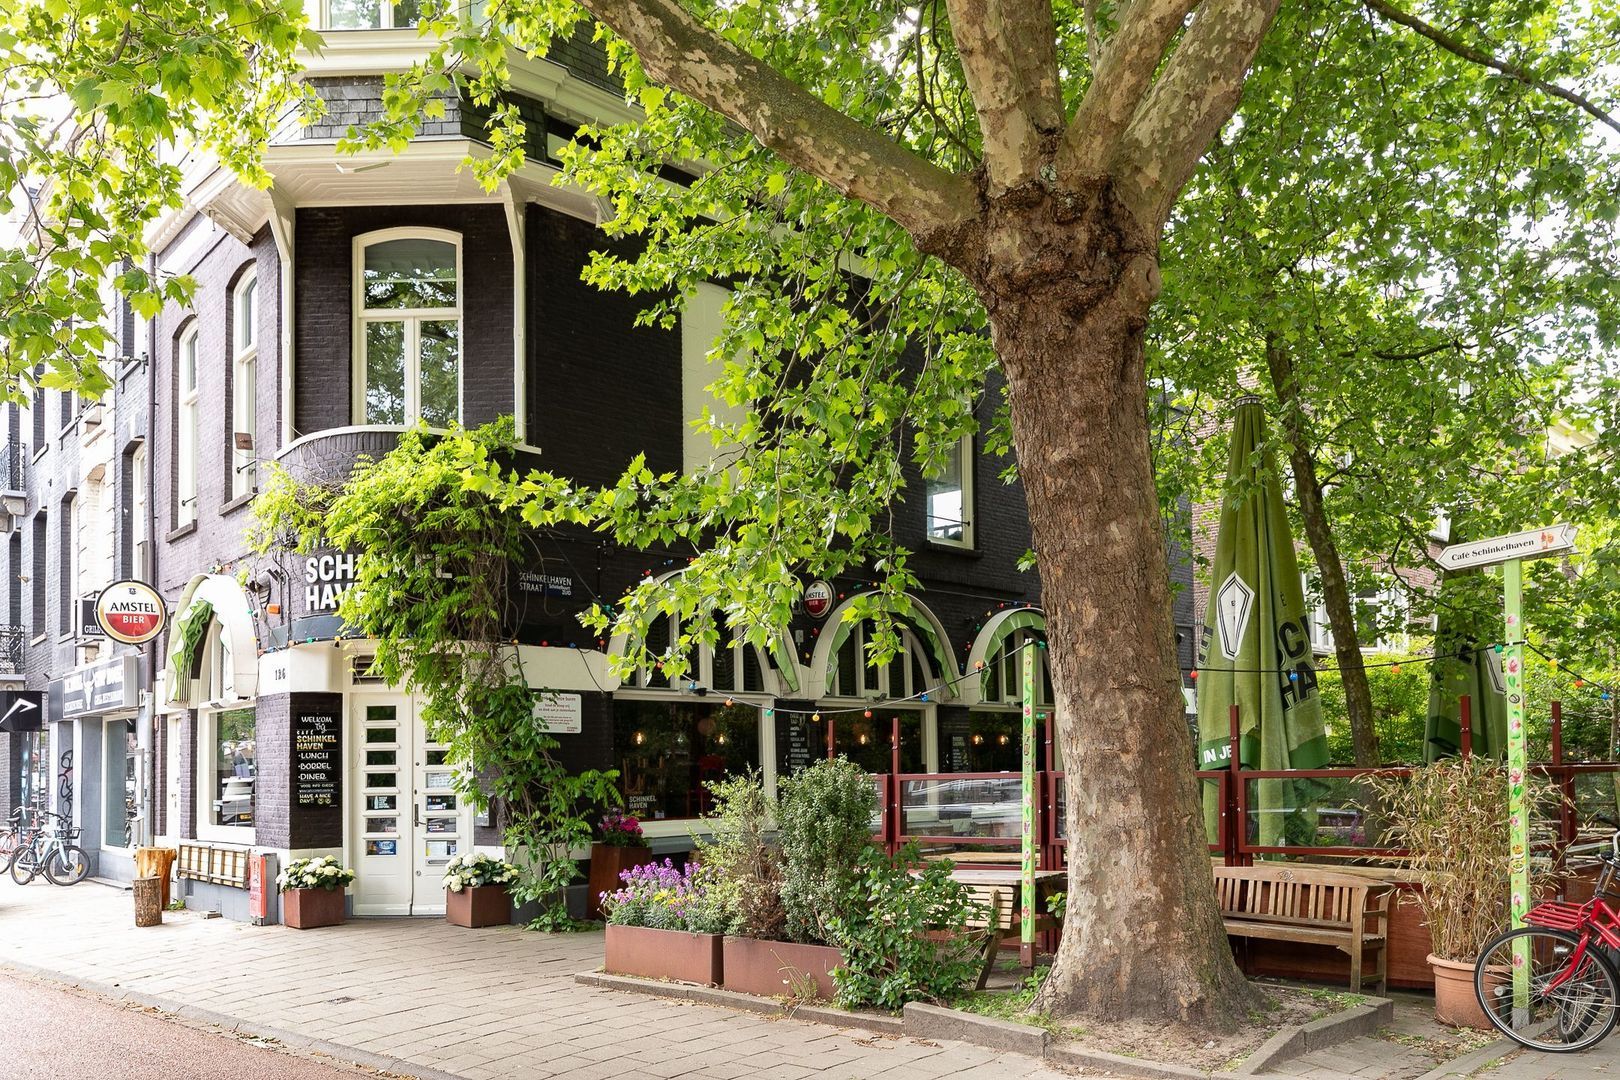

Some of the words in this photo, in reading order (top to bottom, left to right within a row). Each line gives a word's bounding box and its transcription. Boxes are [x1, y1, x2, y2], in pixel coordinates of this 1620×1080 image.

[1451, 552, 1470, 561] Café
[1472, 540, 1534, 557] Schinkelhaven
[519, 570, 572, 586] SCHINKELHAVEN
[519, 582, 543, 592] STRAAT
[110, 602, 156, 613] AMSTEL
[122, 615, 145, 624] BIER
[296, 735, 337, 743] SCHINKEL
[296, 742, 324, 750] HAVEN
[1203, 748, 1217, 764] IN
